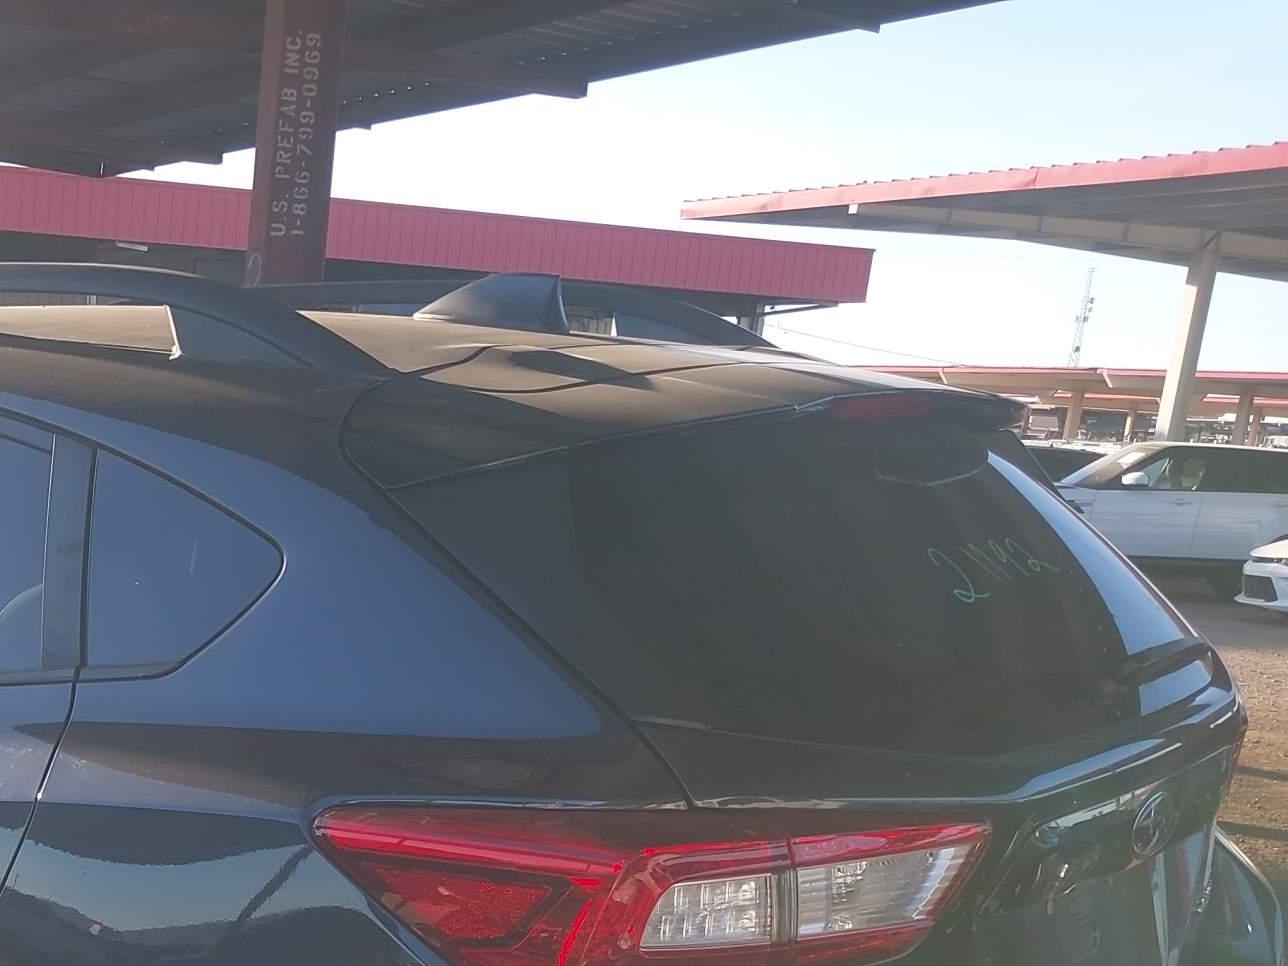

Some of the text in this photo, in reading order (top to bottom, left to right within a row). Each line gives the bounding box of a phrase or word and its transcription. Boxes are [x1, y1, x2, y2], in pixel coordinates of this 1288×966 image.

[270, 30, 303, 236] U.S. PREFAB INC.
[290, 33, 322, 235] 1-866-799-0969
